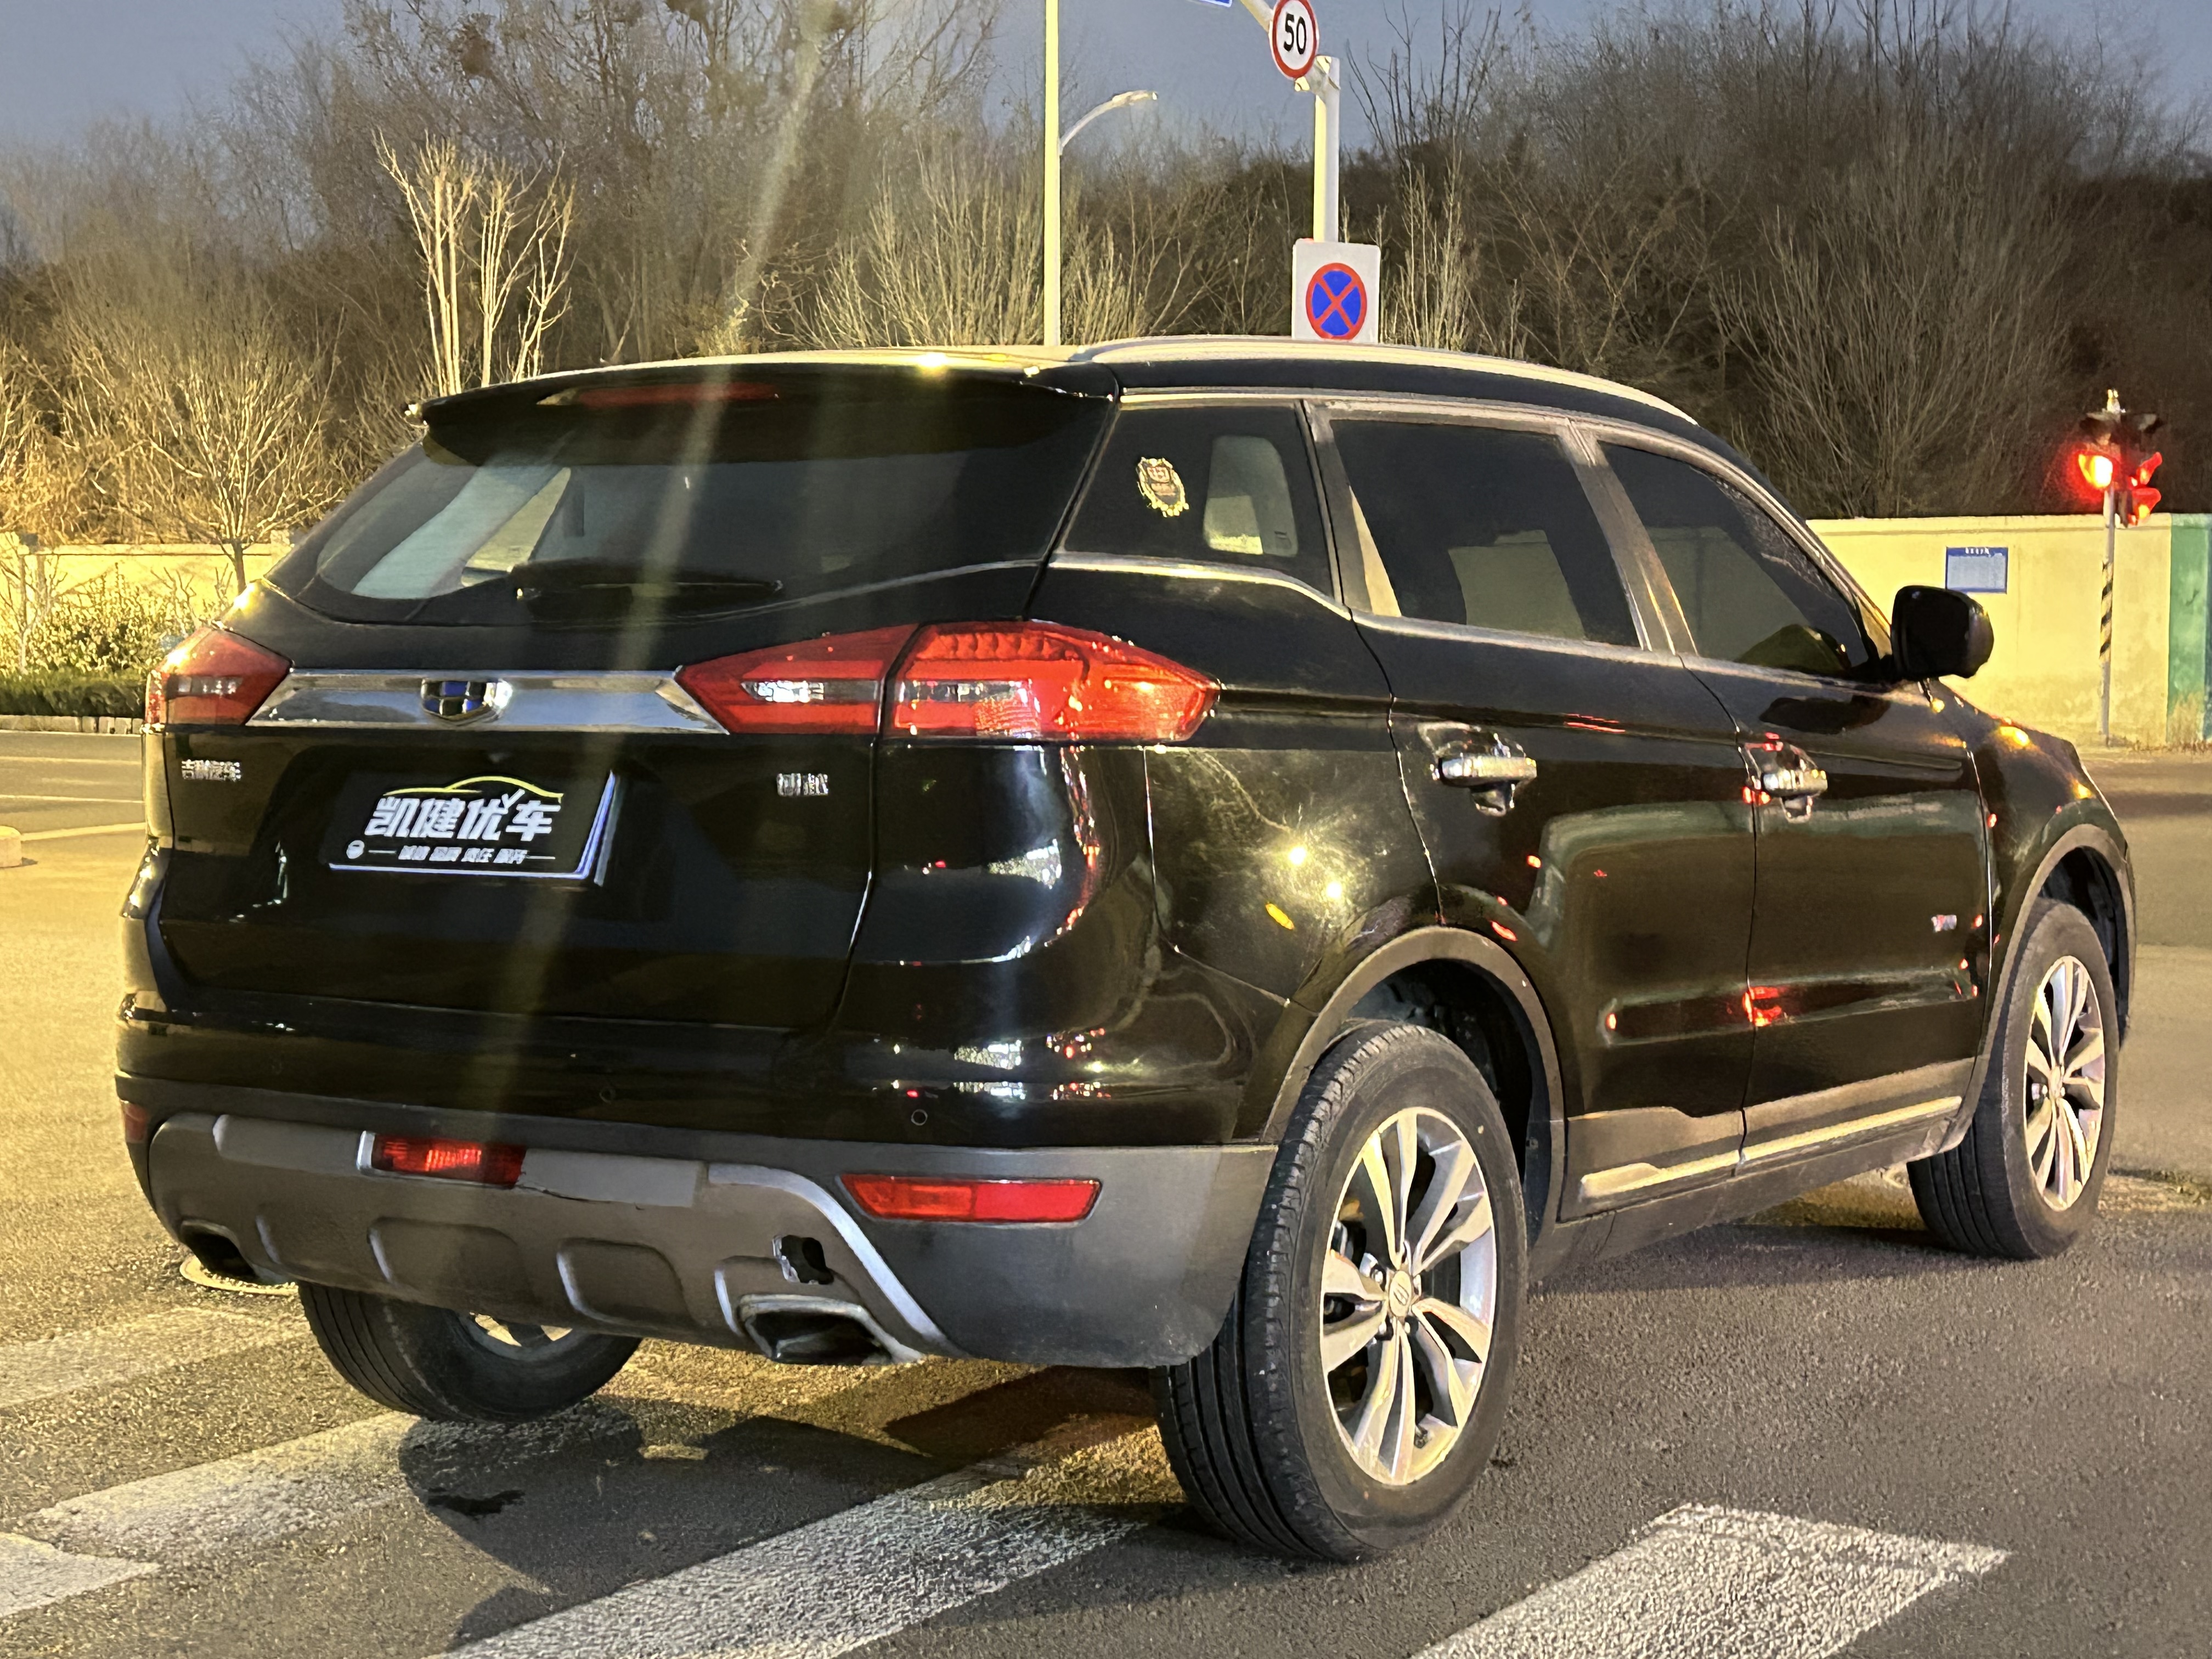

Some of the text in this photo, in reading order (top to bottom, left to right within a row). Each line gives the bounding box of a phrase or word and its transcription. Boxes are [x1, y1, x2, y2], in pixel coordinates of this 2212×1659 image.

[1284, 12, 1307, 55] 50
[364, 789, 561, 842] 凯健优车
